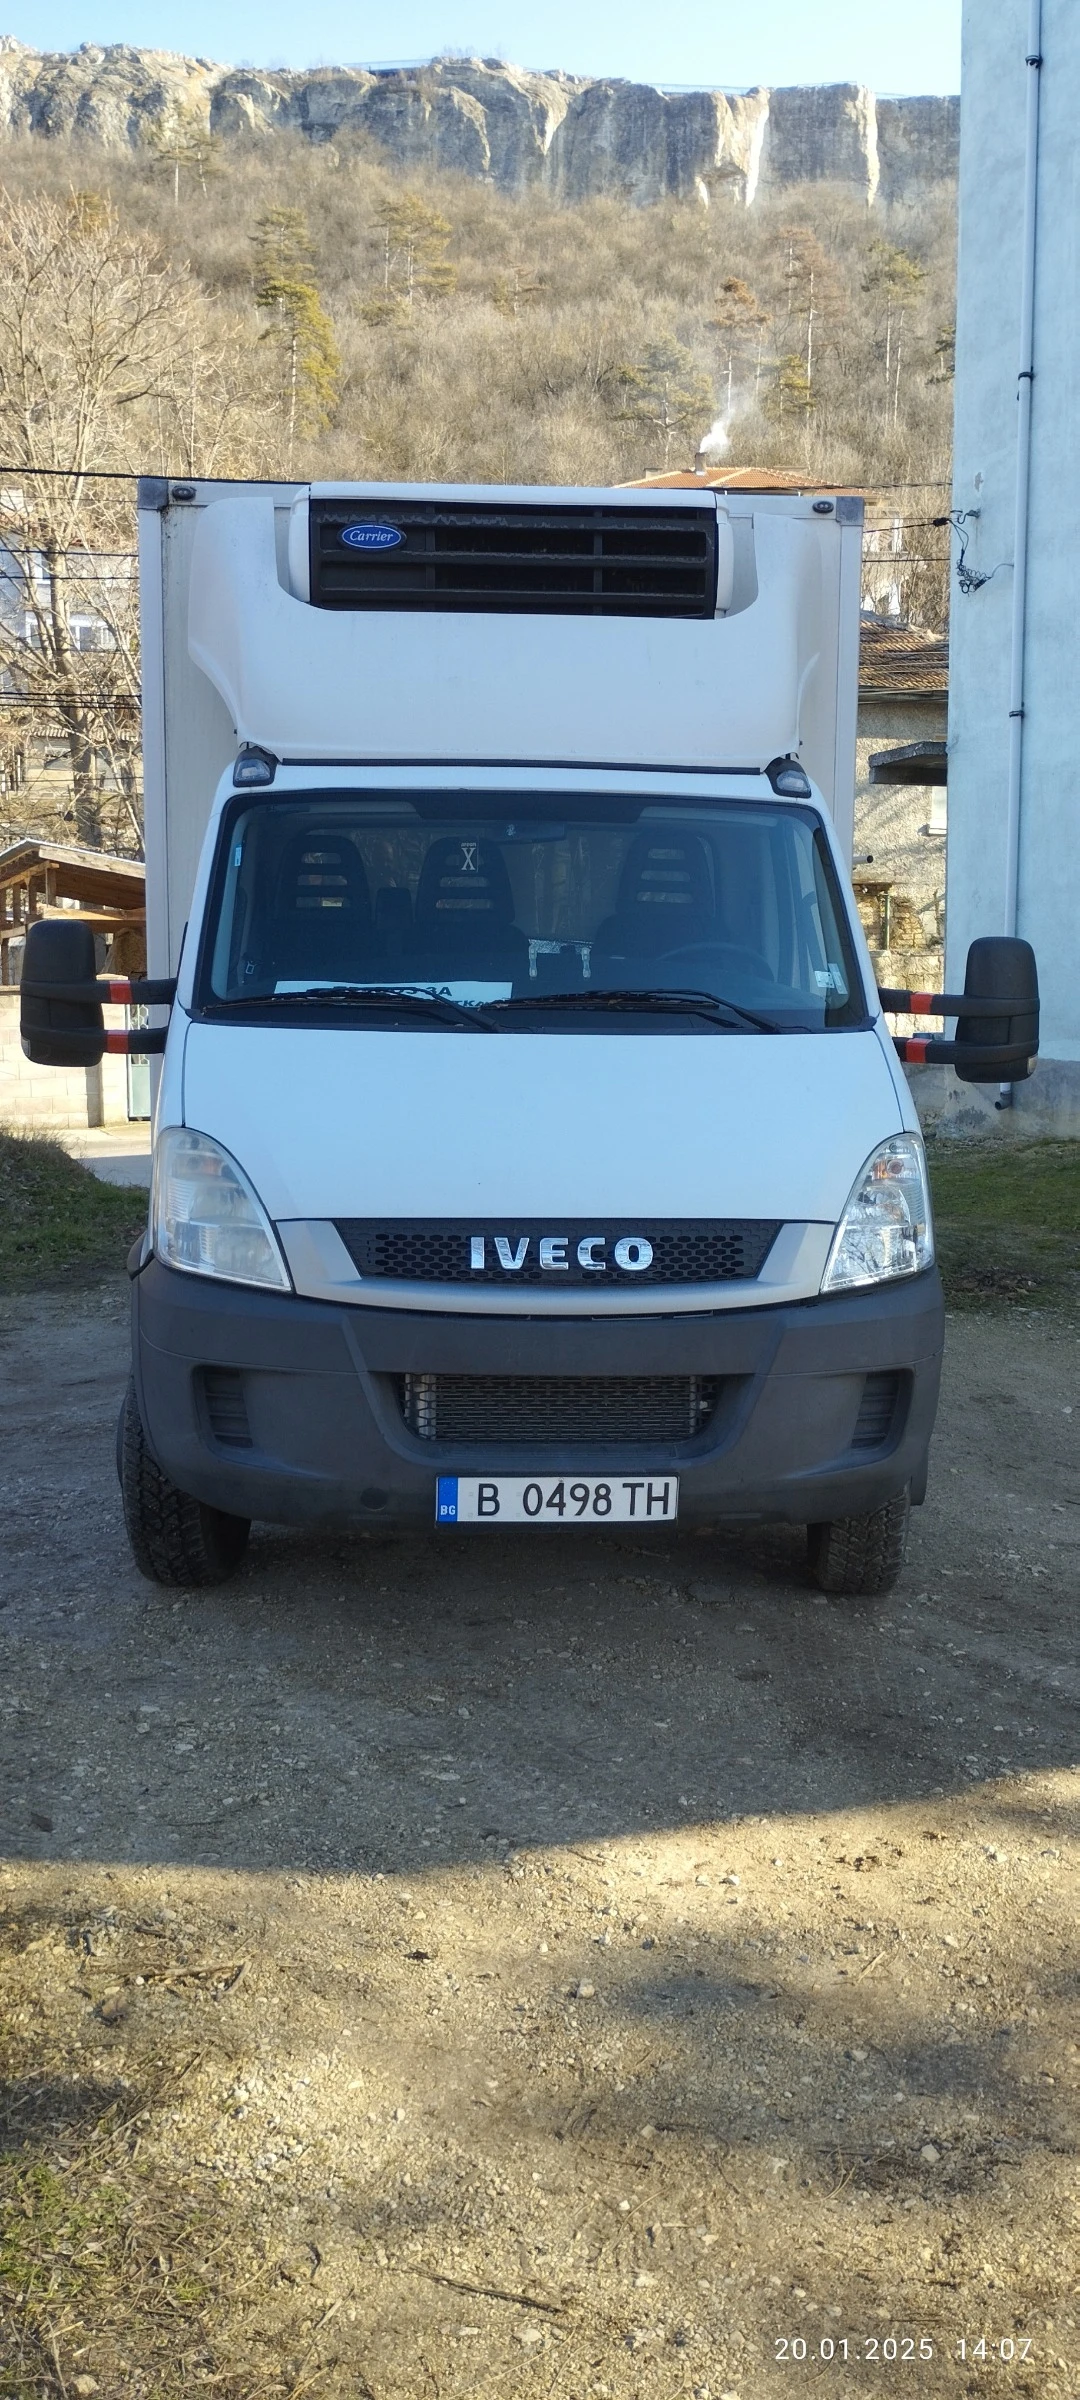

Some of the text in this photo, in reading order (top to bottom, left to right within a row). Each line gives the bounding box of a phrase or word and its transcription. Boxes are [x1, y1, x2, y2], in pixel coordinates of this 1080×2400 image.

[349, 530, 394, 541] Carrier
[470, 1236, 653, 1270] IVECO
[440, 1505, 456, 1516] BG
[477, 1482, 670, 1517] B 0498 TH
